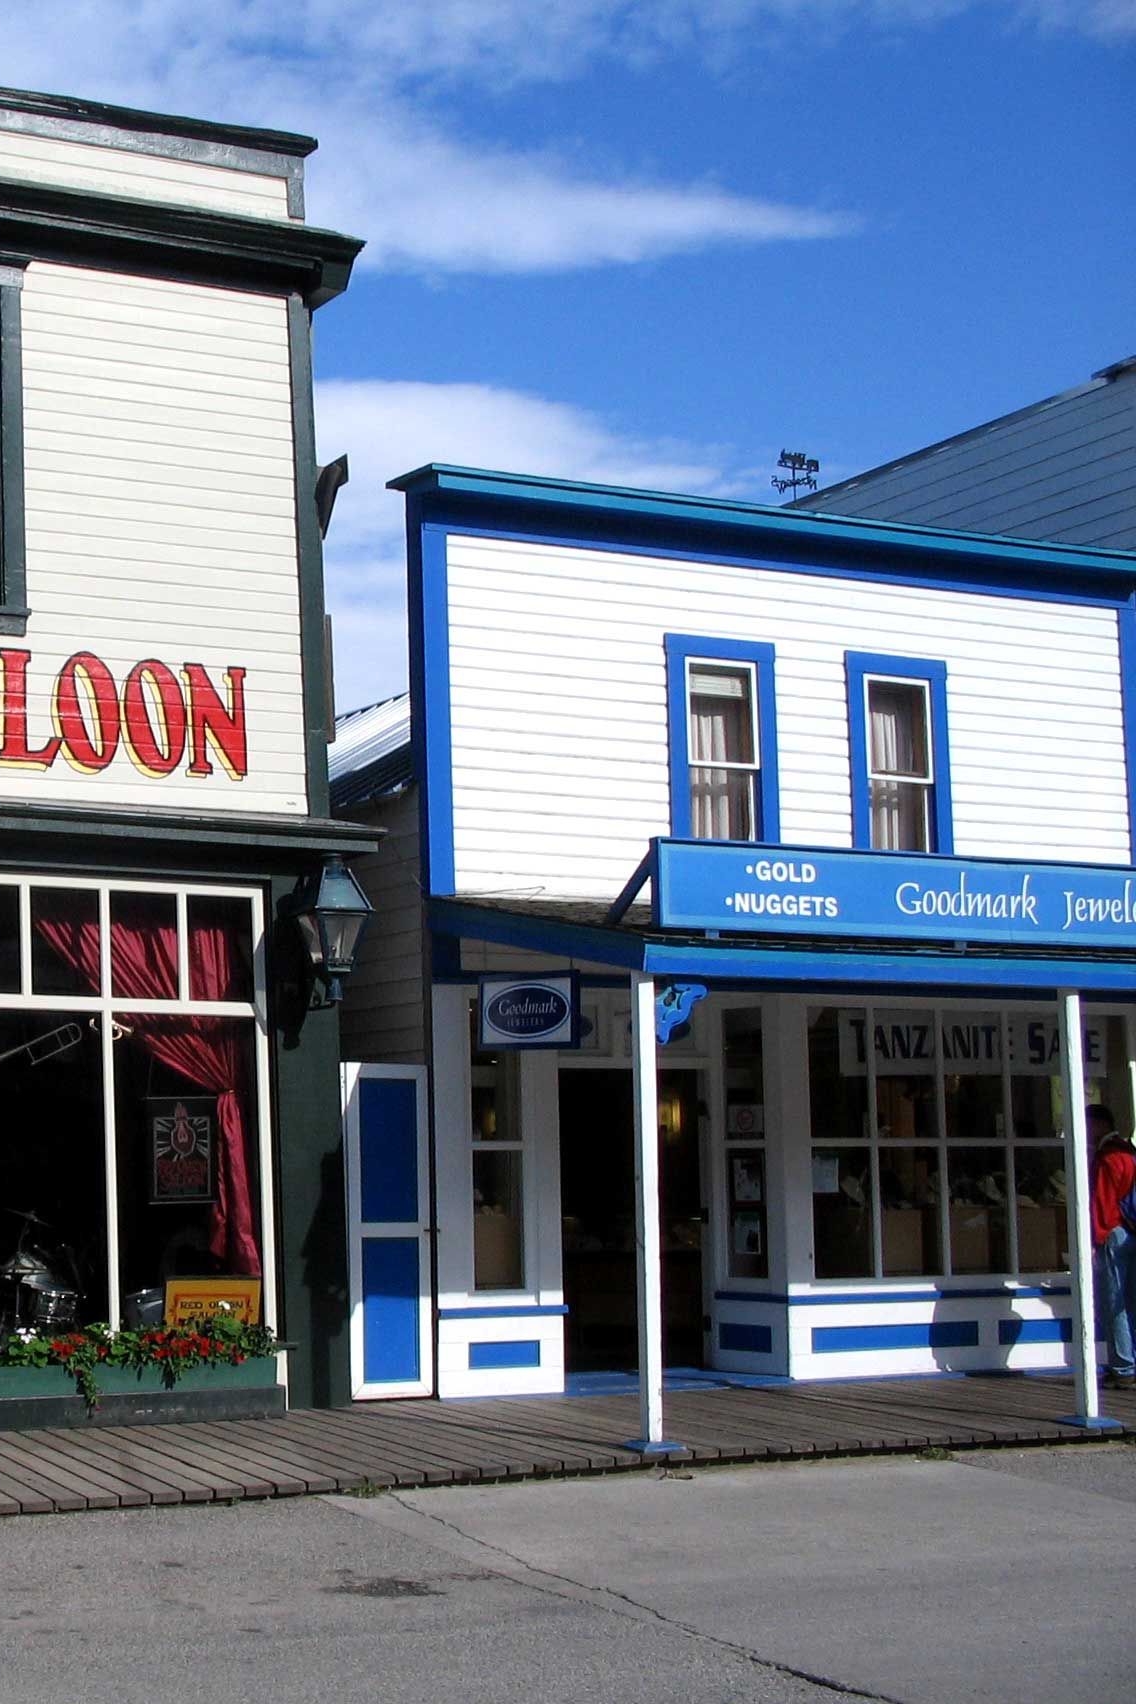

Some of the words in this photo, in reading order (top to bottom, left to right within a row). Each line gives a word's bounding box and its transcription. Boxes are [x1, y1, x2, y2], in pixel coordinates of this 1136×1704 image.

[755, 860, 816, 883] GOLD
[734, 892, 839, 918] NUGGETS
[895, 871, 1039, 925] Goodmark
[497, 995, 558, 1017] Goodmark
[849, 1018, 1014, 1064] TANZANIT
[1027, 1021, 1101, 1065] SAE
[180, 1301, 203, 1310] RED
[208, 1301, 243, 1311] OON
